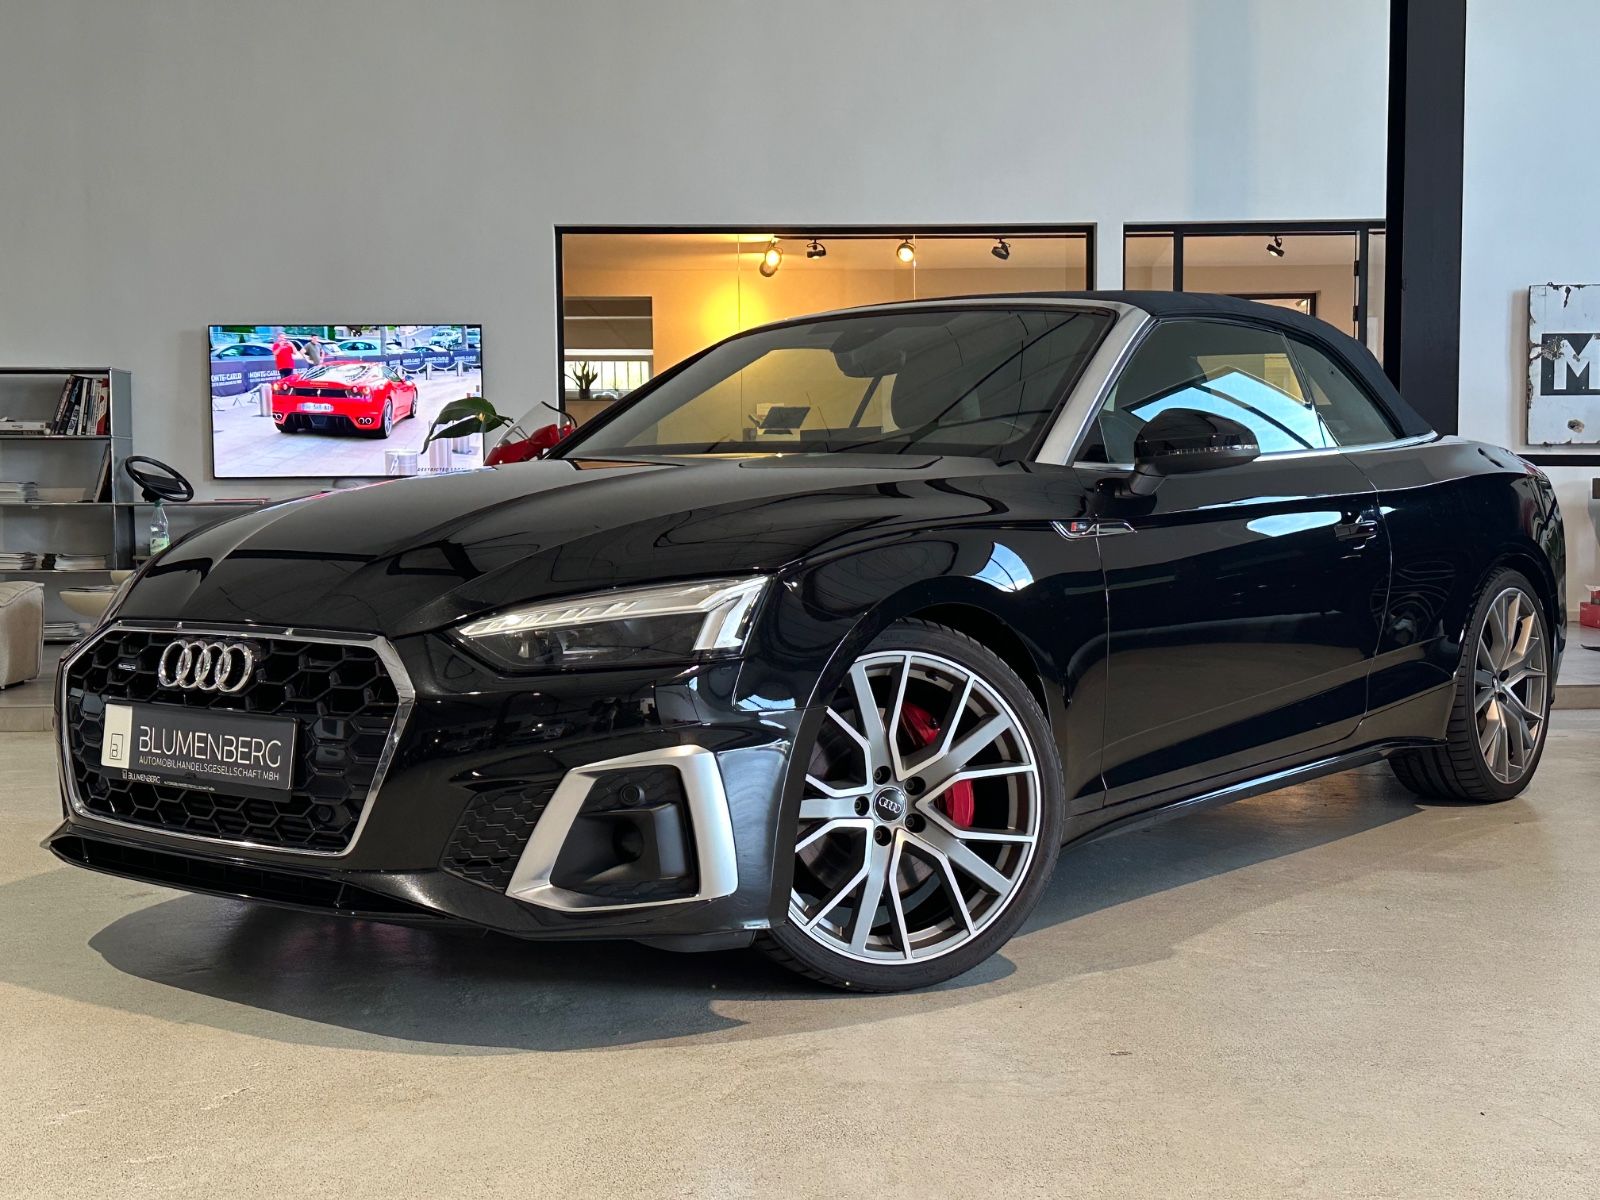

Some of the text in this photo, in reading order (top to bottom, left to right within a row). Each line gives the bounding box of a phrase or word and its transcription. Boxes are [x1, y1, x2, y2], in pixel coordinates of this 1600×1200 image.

[211, 373, 242, 382] ONTE-CARLO
[139, 725, 282, 768] BLUMENBERG
[139, 755, 262, 779] AUTOMOBILHANDELSGESELLSCHAFT
[263, 772, 279, 781] MBH
